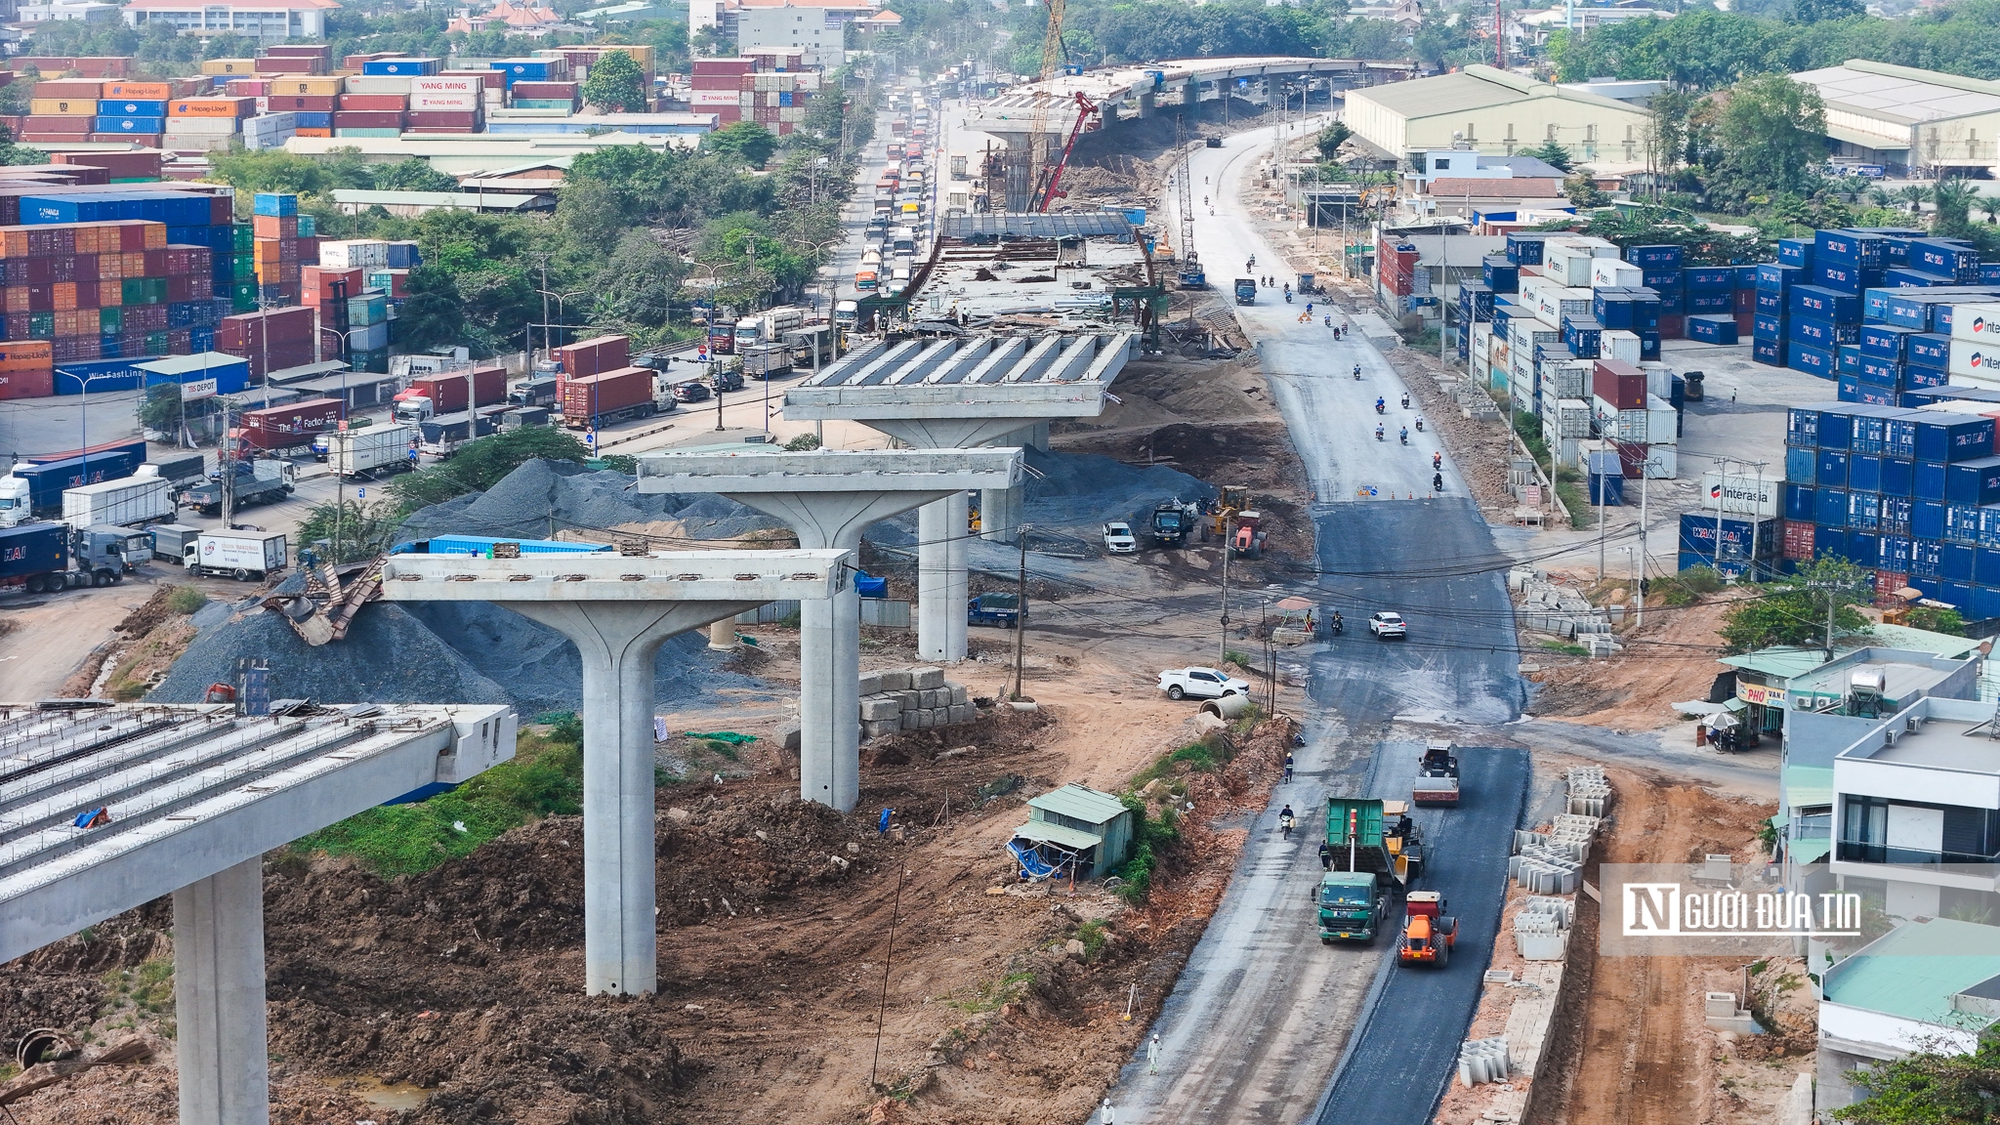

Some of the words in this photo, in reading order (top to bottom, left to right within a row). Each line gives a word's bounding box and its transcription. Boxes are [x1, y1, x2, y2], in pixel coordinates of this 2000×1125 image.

[125, 87, 160, 96] Hapag-Lloyd
[420, 82, 443, 90] YANG
[445, 82, 467, 90] MING
[191, 105, 227, 113] Hapag-Lloyd
[10, 352, 49, 360] Hapag-Lloyd
[196, 381, 215, 392] DEPOT
[278, 423, 291, 433] The
[304, 417, 324, 428] Factor
[1723, 487, 1768, 503] Interasia
[1692, 526, 1716, 540] WAN
[4, 545, 26, 562] HAI
